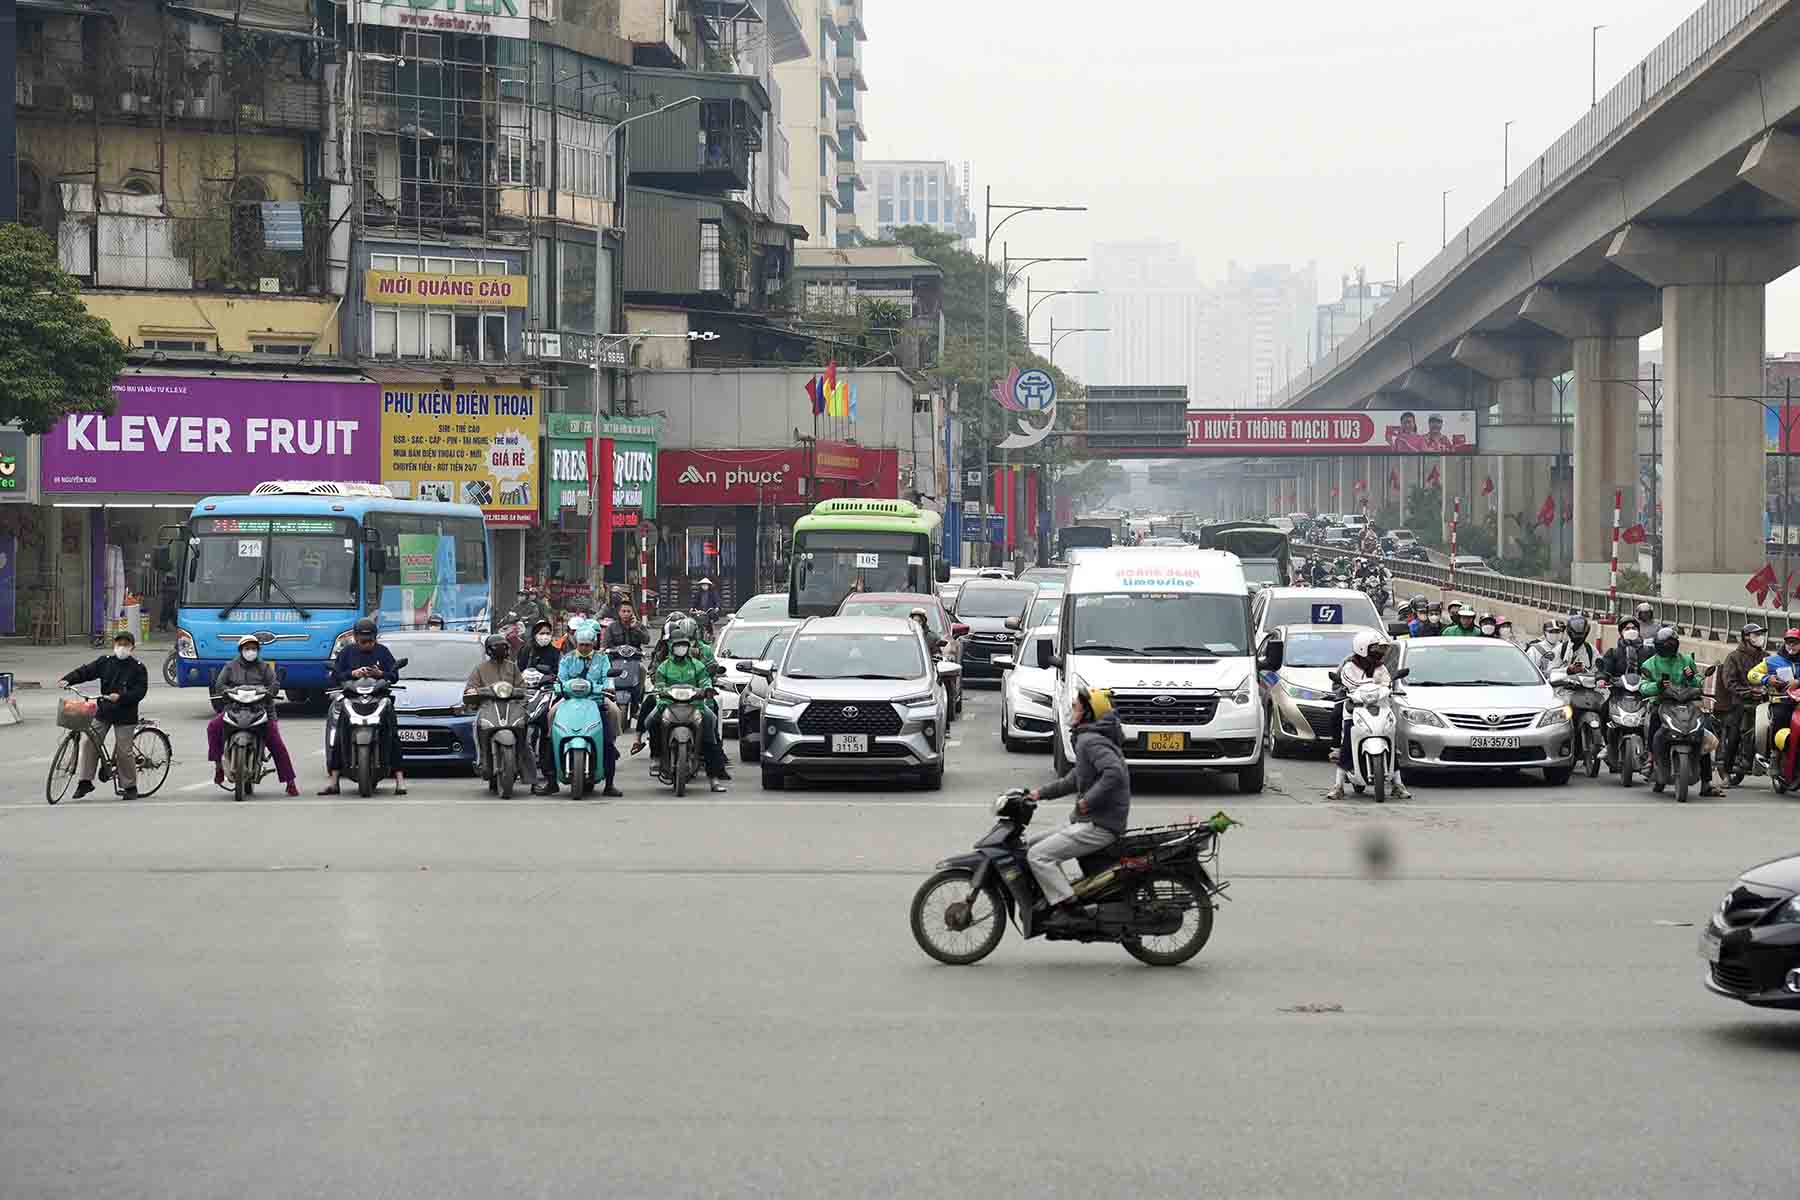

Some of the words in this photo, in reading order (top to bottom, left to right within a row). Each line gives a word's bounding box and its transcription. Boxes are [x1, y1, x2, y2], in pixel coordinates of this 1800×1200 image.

[379, 275, 411, 294] MỜI
[417, 274, 473, 296] QUẢNG
[479, 279, 512, 297] CÁO
[384, 391, 414, 419] PHỤ
[418, 388, 451, 419] KIỆN
[456, 390, 489, 420] ĐIỆN
[494, 394, 533, 421] THOẠI
[67, 414, 232, 453] KLEVER
[246, 418, 359, 455] FRUIT
[1204, 414, 1242, 440] HUYẾT
[1291, 419, 1329, 443] MẠCH
[1333, 419, 1361, 440] TW3
[492, 448, 509, 467] GIÁ
[512, 447, 526, 467] RẺ
[552, 448, 589, 481] FRES
[860, 555, 877, 565] 105
